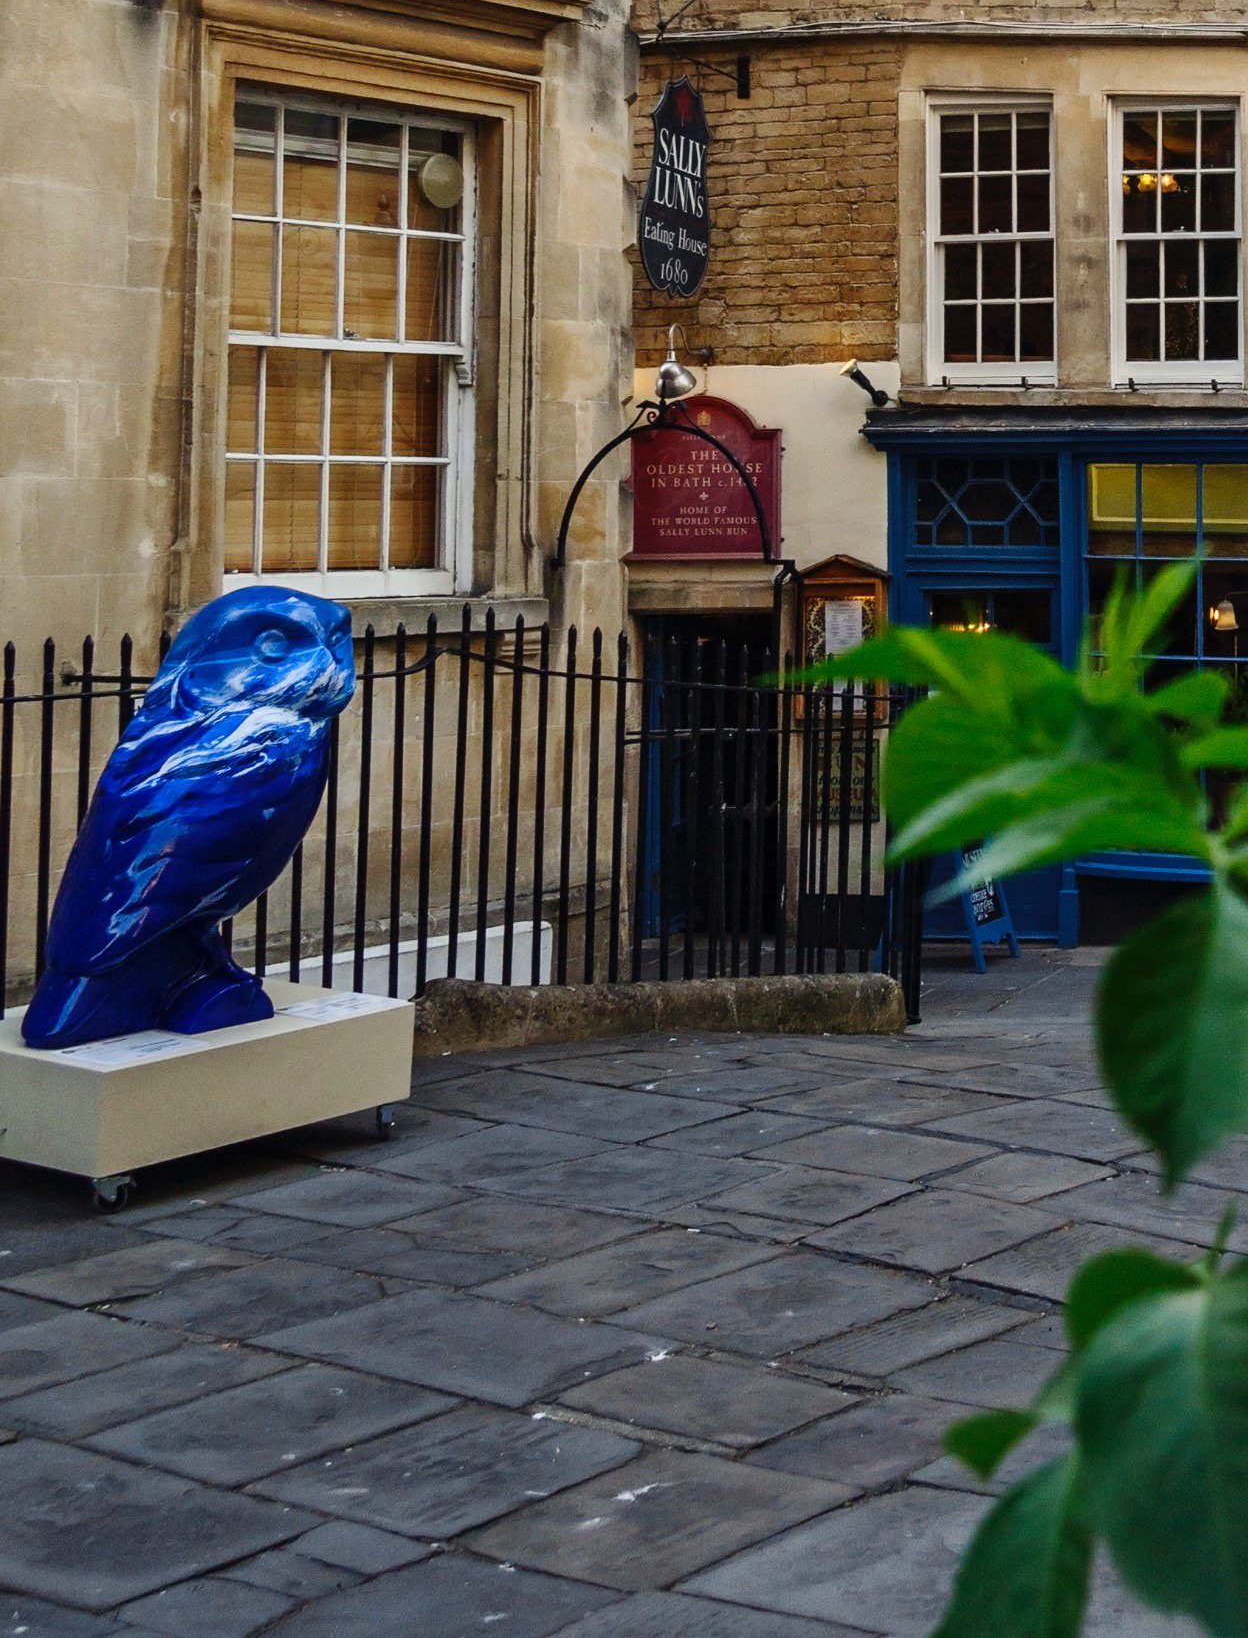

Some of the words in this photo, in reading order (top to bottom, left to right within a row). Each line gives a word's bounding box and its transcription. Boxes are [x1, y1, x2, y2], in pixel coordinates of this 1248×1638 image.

[658, 127, 706, 178] SALLY
[644, 216, 675, 250] Eating
[678, 227, 708, 256] House
[660, 257, 688, 285] 1680
[690, 450, 719, 461] THE
[646, 463, 704, 475] OLDEST
[711, 462, 763, 474] HOSE
[651, 477, 666, 488] IN
[673, 477, 712, 487] BATH
[718, 476, 757, 487] c.142
[680, 506, 710, 515] HOME
[713, 506, 728, 514] OF
[651, 518, 670, 526] THE
[675, 517, 710, 525] WORLD
[714, 516, 757, 525] FAMOUS
[659, 528, 690, 536] SALLY
[694, 528, 723, 536] LUNN
[726, 527, 748, 535] BUN
